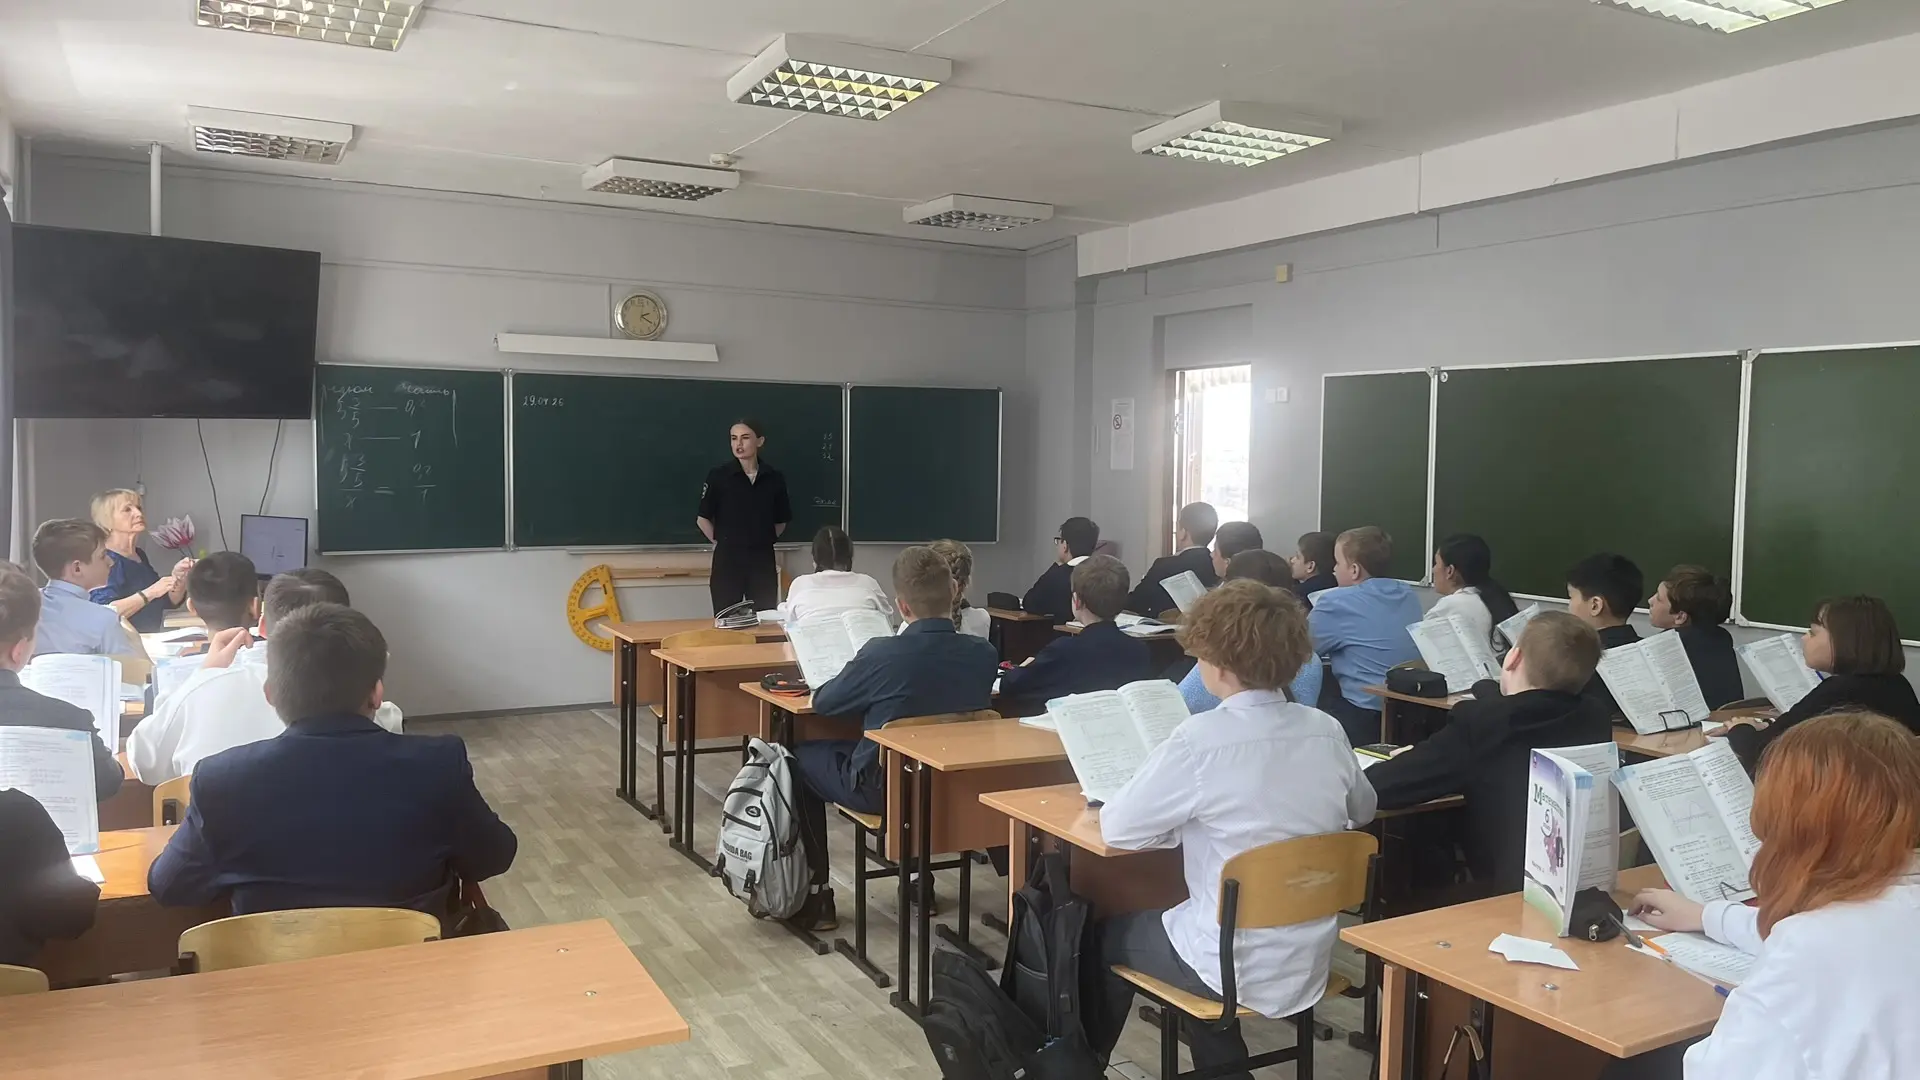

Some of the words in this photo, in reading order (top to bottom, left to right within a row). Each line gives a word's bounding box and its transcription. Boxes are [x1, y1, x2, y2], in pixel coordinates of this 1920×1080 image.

[1533, 783, 1565, 819] Матем
[1544, 808, 1550, 824] 6
[740, 849, 752, 860] BAG
